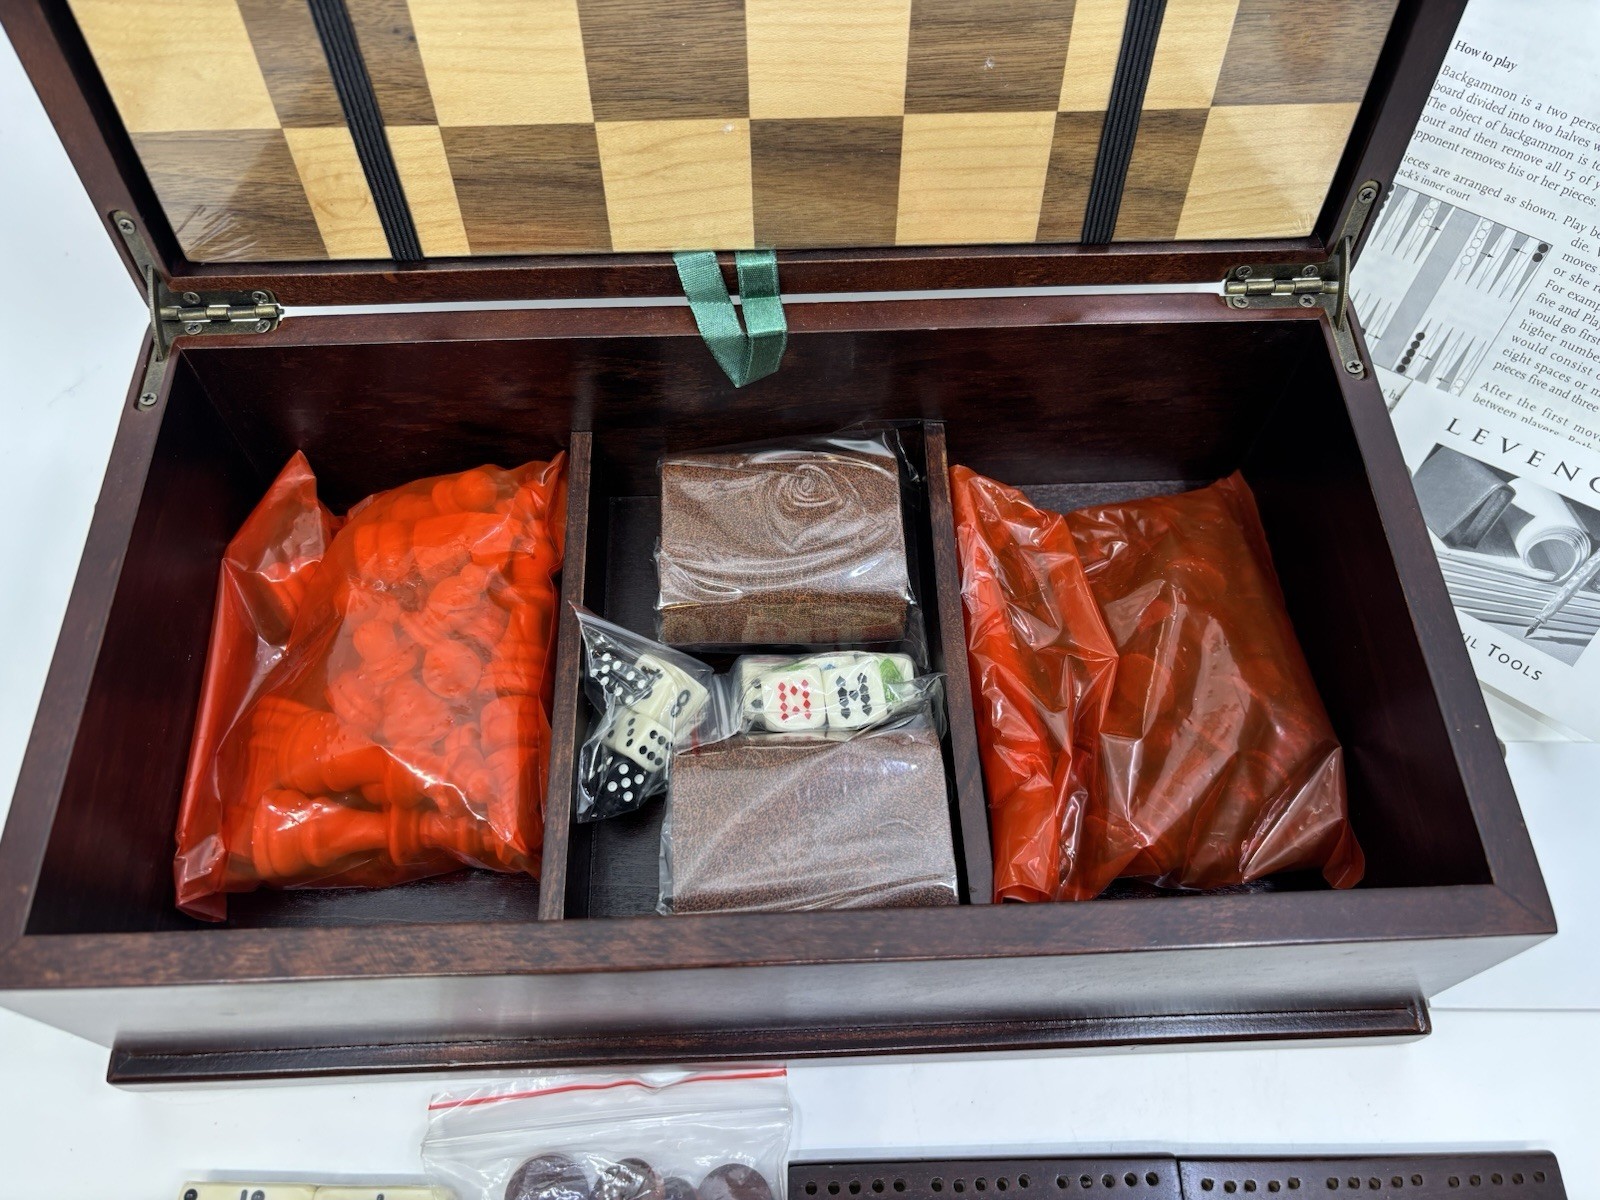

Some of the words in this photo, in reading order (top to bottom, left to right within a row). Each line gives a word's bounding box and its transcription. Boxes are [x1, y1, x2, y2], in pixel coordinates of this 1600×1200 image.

[1454, 40, 1481, 57] How
[1482, 51, 1493, 62] to
[1492, 56, 1518, 73] play
[1441, 65, 1517, 101] Backgammon
[1521, 94, 1532, 106] is
[1535, 102, 1542, 111] a
[1546, 105, 1568, 120] two
[1427, 95, 1447, 111] The
[1450, 106, 1482, 125] object
[1485, 120, 1501, 131] of
[1500, 123, 1574, 160] backgammon
[1577, 153, 1589, 166] is
[1432, 80, 1466, 100] board
[1466, 92, 1508, 115] divided
[1507, 108, 1530, 125] into
[1532, 119, 1553, 133] two
[1555, 126, 1591, 148] halves
[1413, 130, 1460, 152] pponent
[1461, 147, 1506, 170] removes
[1507, 162, 1525, 177] his
[1527, 173, 1540, 183] or
[1540, 175, 1561, 191] her
[1560, 187, 1597, 207] pieces.
[1421, 113, 1446, 129] ourt
[1448, 125, 1471, 138] and
[1473, 132, 1498, 149] then
[1501, 145, 1543, 166] remove
[1545, 161, 1562, 173] all
[1563, 169, 1576, 181] 15
[1579, 175, 1595, 186] of
[1421, 175, 1445, 190] inner
[1446, 187, 1470, 201] court
[1433, 166, 1450, 178] are
[1453, 174, 1503, 198] arranged
[1504, 194, 1517, 204] as
[1519, 199, 1557, 221] shown.
[1563, 215, 1587, 233] Play
[1561, 253, 1598, 273] moves
[1571, 237, 1590, 253] die.
[1545, 279, 1565, 294] For
[1553, 267, 1566, 277] or
[1569, 274, 1590, 287] she
[1529, 309, 1562, 327] would
[1561, 324, 1576, 333] go
[1536, 293, 1556, 308] five
[1558, 304, 1581, 318] and
[1519, 319, 1557, 342] higher
[1502, 348, 1532, 365] eight
[1534, 362, 1571, 383] spaces
[1574, 381, 1588, 390] or
[1512, 335, 1548, 355] would
[1550, 352, 1593, 375] consist
[1473, 392, 1517, 419] between
[1480, 382, 1512, 400] After
[1517, 398, 1537, 412] the
[1541, 407, 1569, 426] first
[1492, 362, 1527, 380] pieces
[1528, 374, 1548, 390] five
[1549, 385, 1572, 399] and
[1571, 394, 1599, 412] three
[1488, 643, 1543, 681] TOOLS
